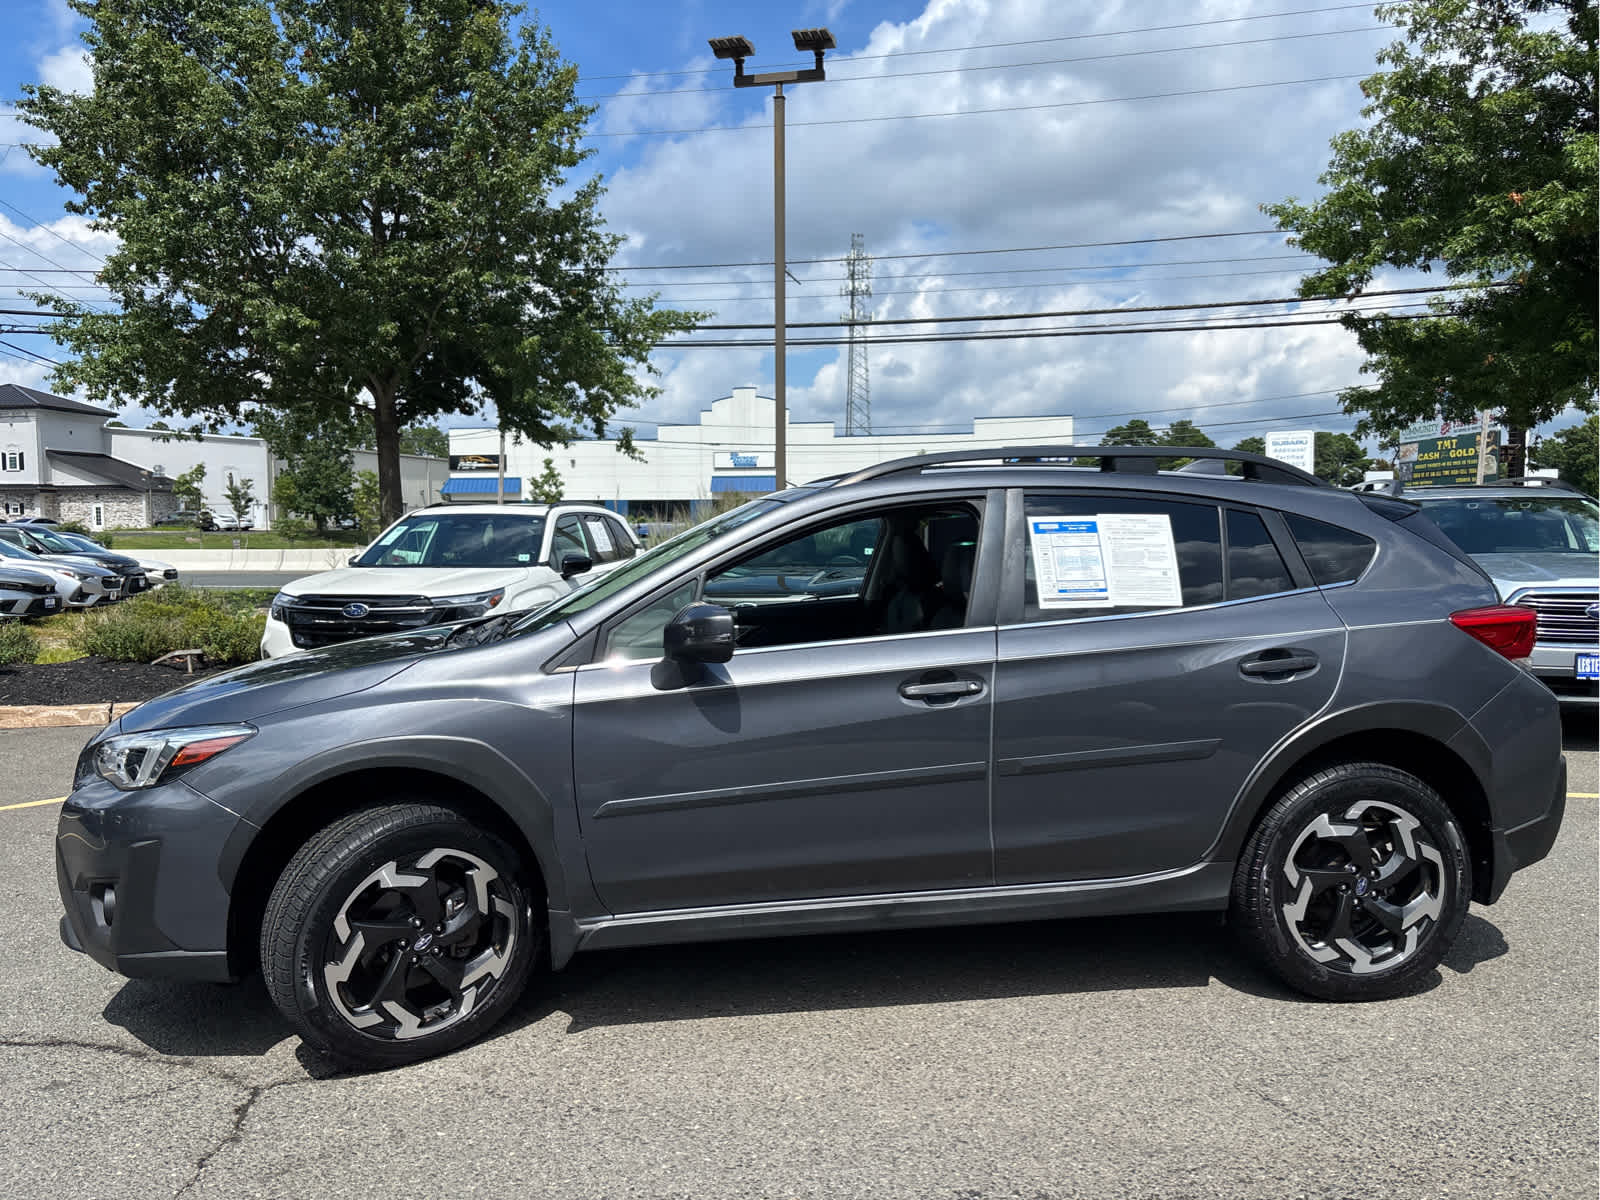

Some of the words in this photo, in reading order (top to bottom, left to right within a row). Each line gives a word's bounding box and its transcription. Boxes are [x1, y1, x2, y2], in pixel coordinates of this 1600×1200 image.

[1436, 439, 1457, 450] TMT
[1418, 452, 1440, 461] CASH
[1449, 448, 1475, 457] GOLD
